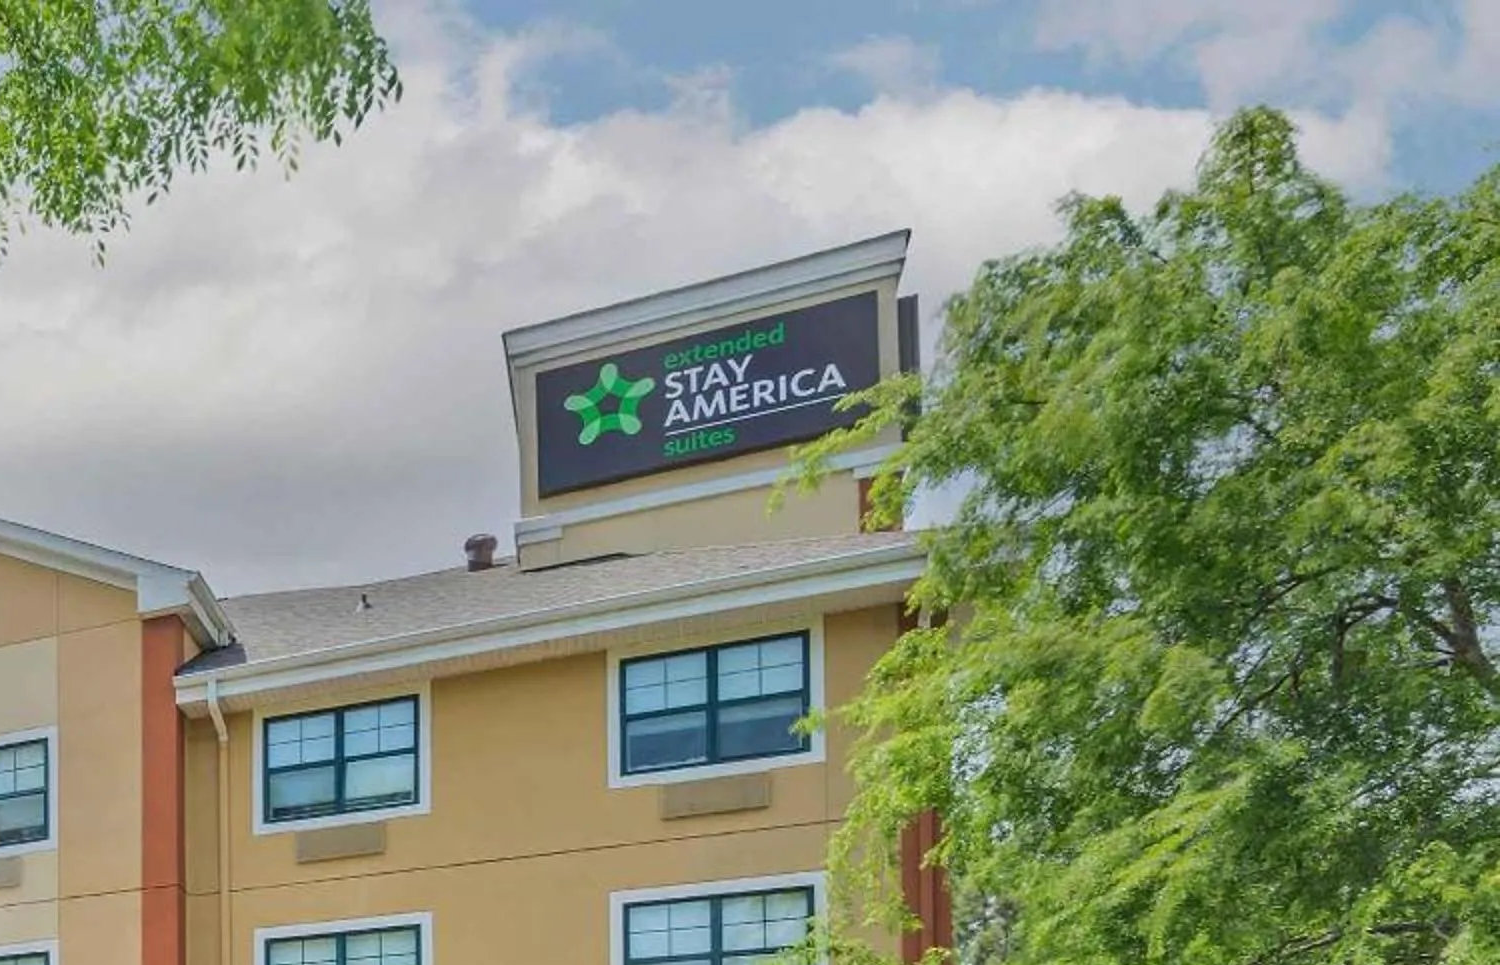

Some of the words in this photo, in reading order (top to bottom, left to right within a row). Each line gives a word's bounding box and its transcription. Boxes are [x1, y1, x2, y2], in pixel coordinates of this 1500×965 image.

[664, 321, 786, 369] extended
[663, 363, 847, 428] AMERICA
[664, 354, 754, 399] STAY
[663, 428, 736, 457] suites
